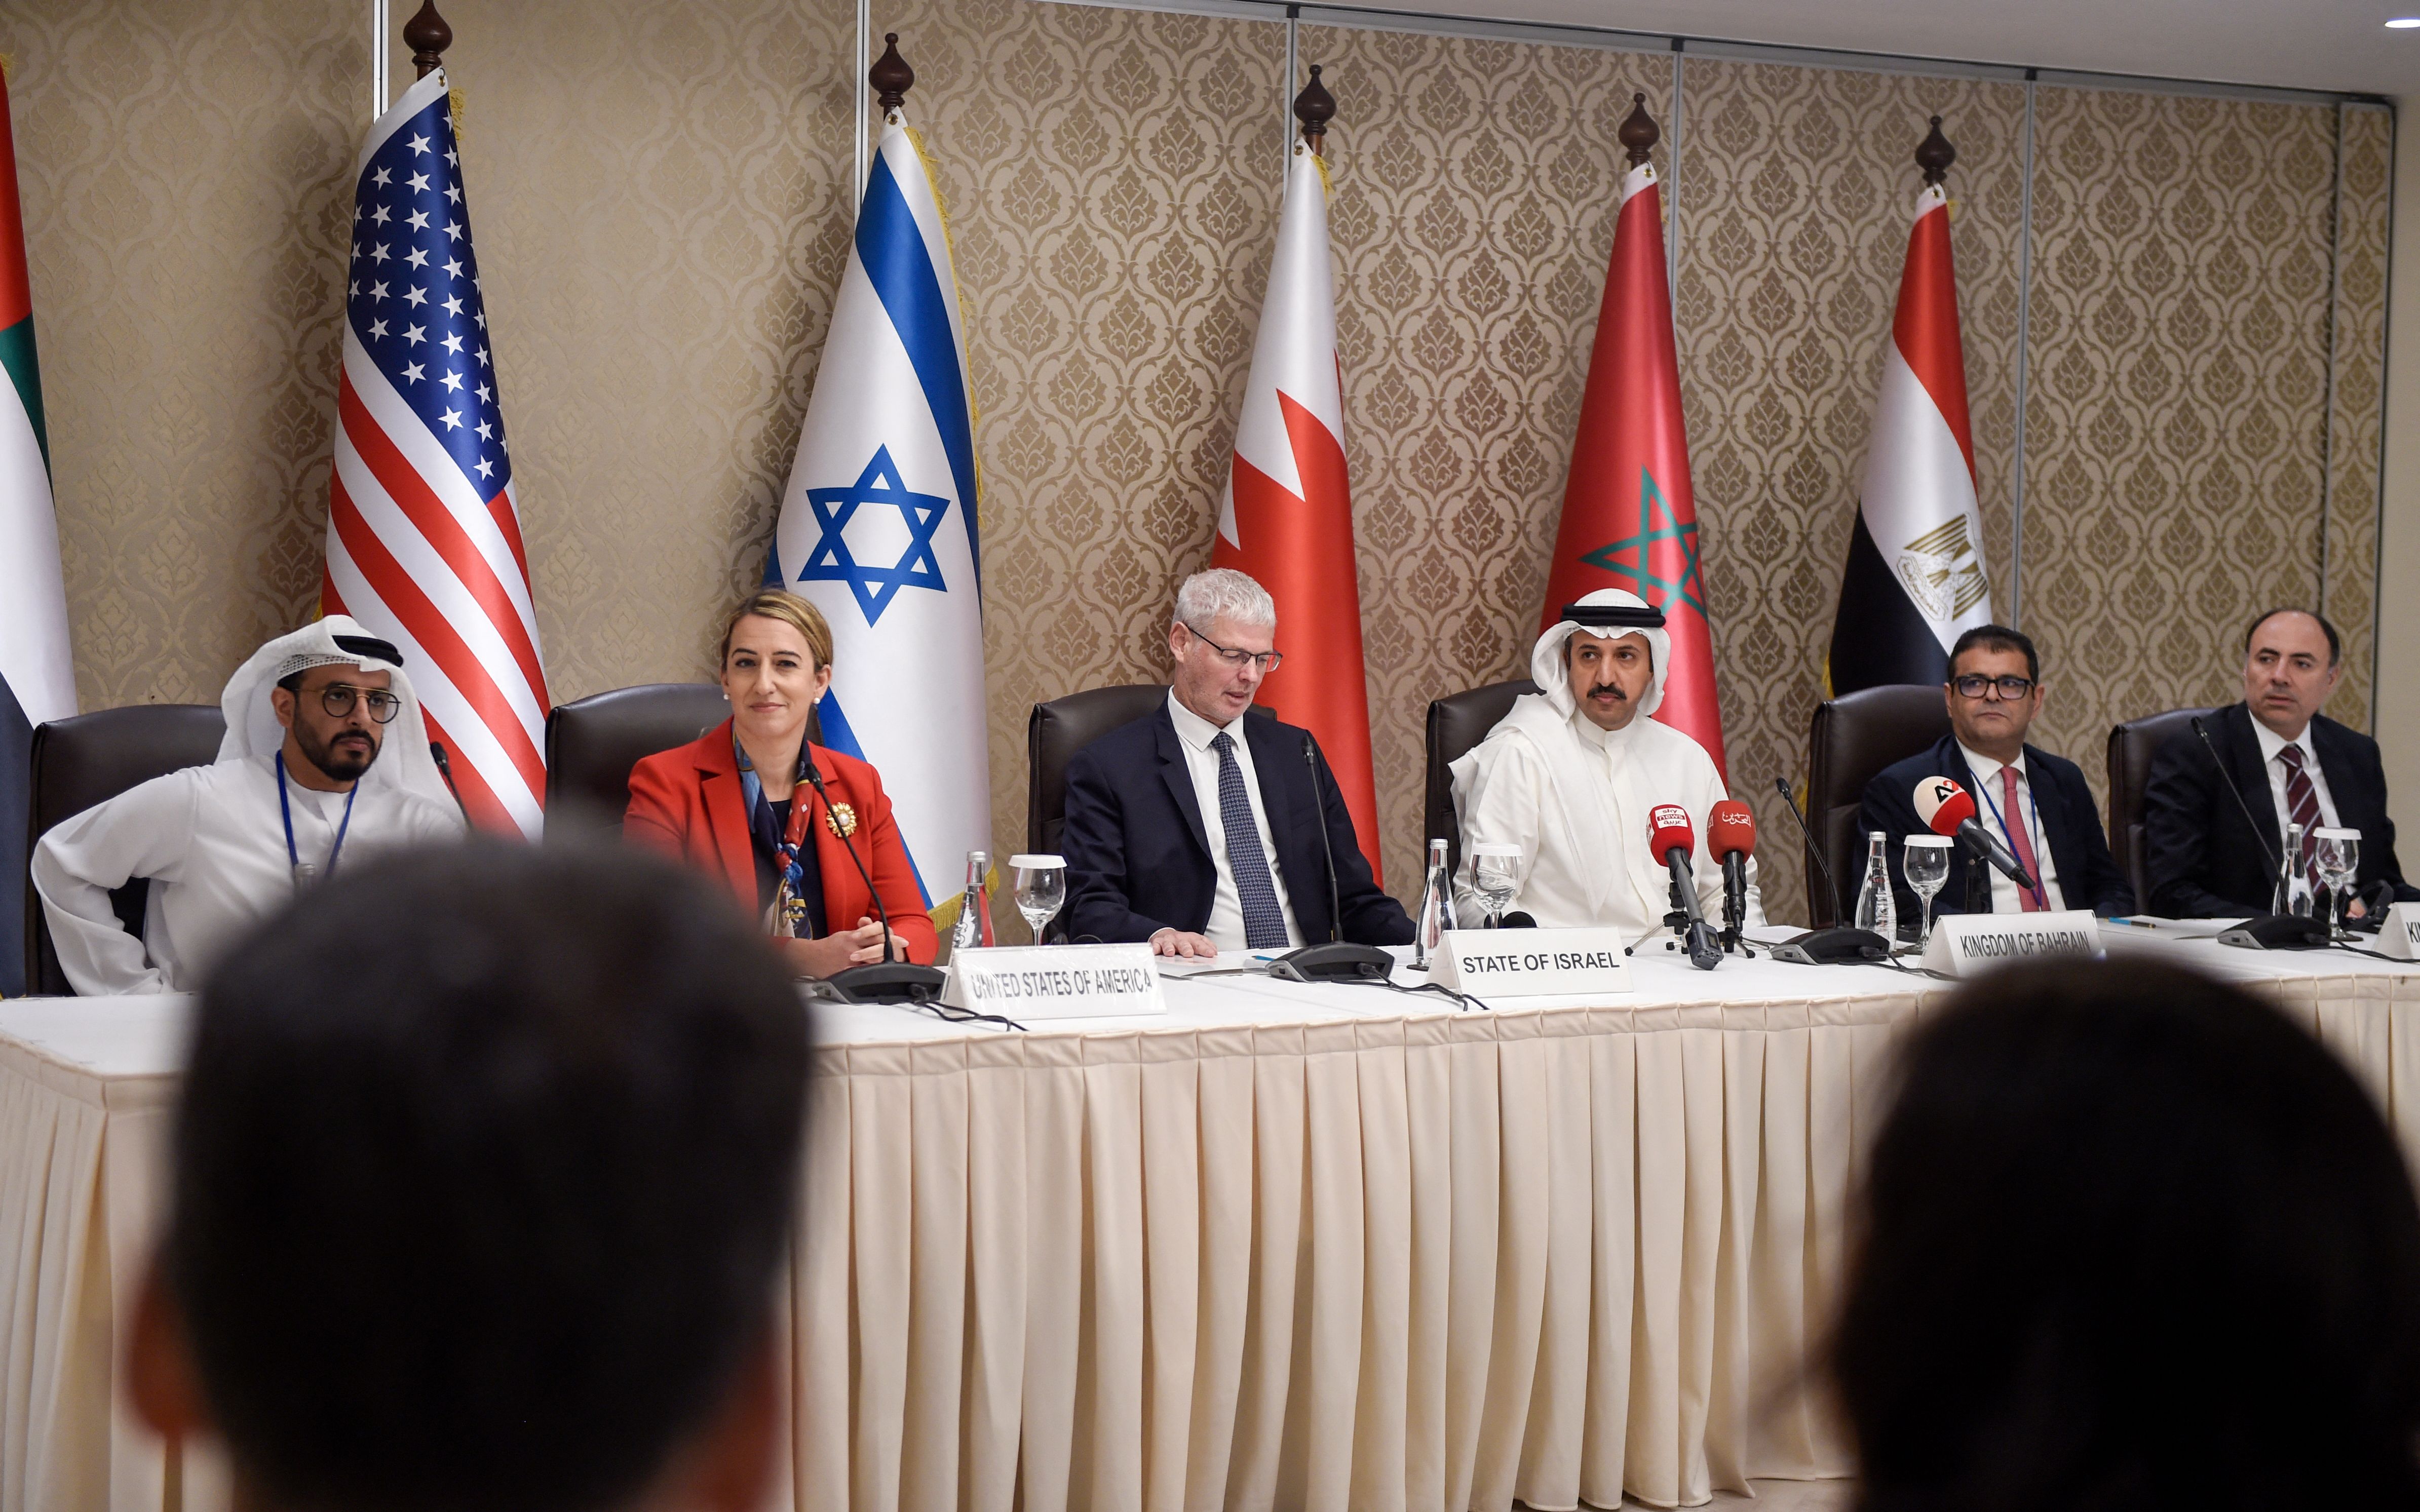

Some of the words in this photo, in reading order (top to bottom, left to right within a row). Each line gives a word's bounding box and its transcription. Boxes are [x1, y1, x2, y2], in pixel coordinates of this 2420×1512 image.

[1960, 934, 2018, 957] KINGDOM
[2019, 933, 2034, 955] OF
[2036, 931, 2091, 953] BAHRAIN
[1463, 955, 1521, 974] STATE
[1524, 954, 1549, 971] OF
[1554, 952, 1620, 970] ISRAEL
[970, 973, 1020, 999] UNITED
[1022, 971, 1072, 997] STATES
[1074, 970, 1092, 995] OF
[1095, 968, 1153, 994] AMERICA
